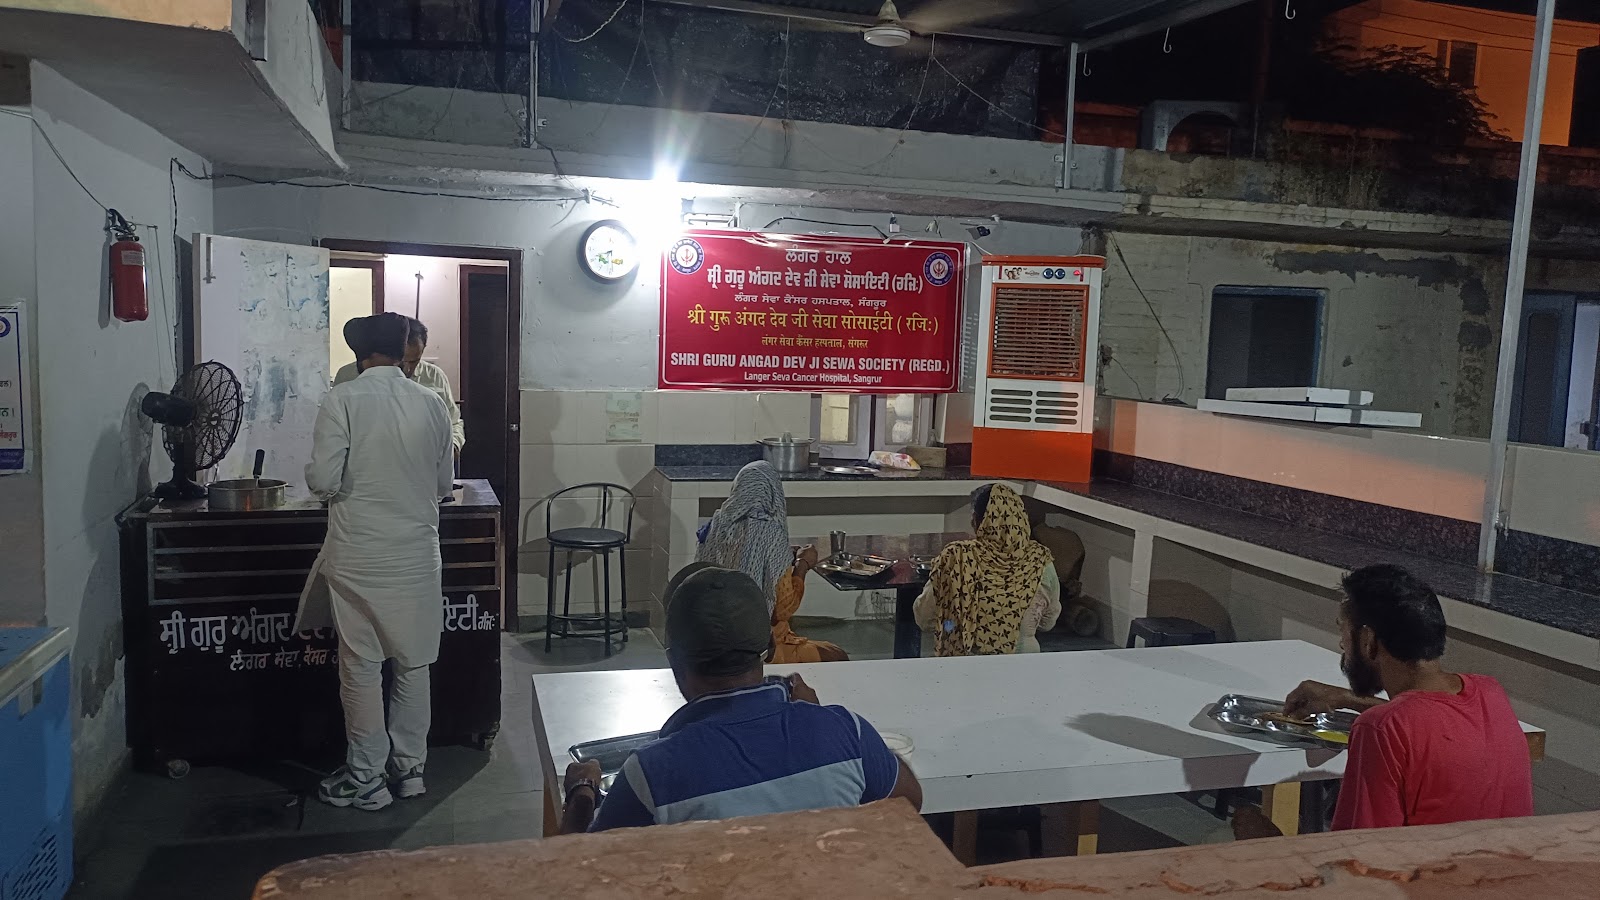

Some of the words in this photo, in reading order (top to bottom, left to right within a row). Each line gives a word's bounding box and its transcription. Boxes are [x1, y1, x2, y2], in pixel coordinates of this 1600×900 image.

[785, 244, 820, 263] ਲੰਗਰ
[825, 250, 852, 264] ਹਾਲ
[724, 269, 745, 290] ਗੁਰੂ
[749, 266, 782, 286] ਅੰਗਦ
[785, 267, 801, 286] ਦੇਵ
[804, 269, 818, 287] ਜੀ
[820, 269, 841, 288] ਸੇਵਾ
[843, 270, 890, 290] ਸੋਸਾਇਟੀ
[734, 292, 758, 303] ਲੰਗਰ
[762, 293, 781, 304] ਸੇਵਾ
[811, 297, 854, 308] ਹਸਪਤਾਲ,
[858, 297, 887, 311] ਸੰਗਰੂਰ
[687, 304, 706, 324] श्री
[734, 307, 767, 327] अंगद
[769, 307, 788, 328] देव
[791, 308, 809, 328] जी
[812, 309, 838, 329] सेवा
[841, 310, 894, 333] सोसाईटी
[761, 334, 778, 346] लंगर
[779, 334, 794, 347] सेवा
[670, 352, 700, 366] SHRI
[703, 353, 736, 367] GURU
[739, 354, 780, 368] ANGAD
[783, 356, 807, 369] DEV
[809, 357, 820, 369] JI
[823, 357, 855, 370] SEWA
[858, 358, 906, 371] SOCIETY
[908, 359, 950, 374] (REGD.)
[744, 371, 771, 383] Langer
[772, 372, 790, 382] Seva
[792, 373, 817, 383] Cancer
[819, 373, 852, 384] Hospital,
[853, 374, 882, 385] Sangrur
[232, 607, 290, 645] ਅੰਗਦ
